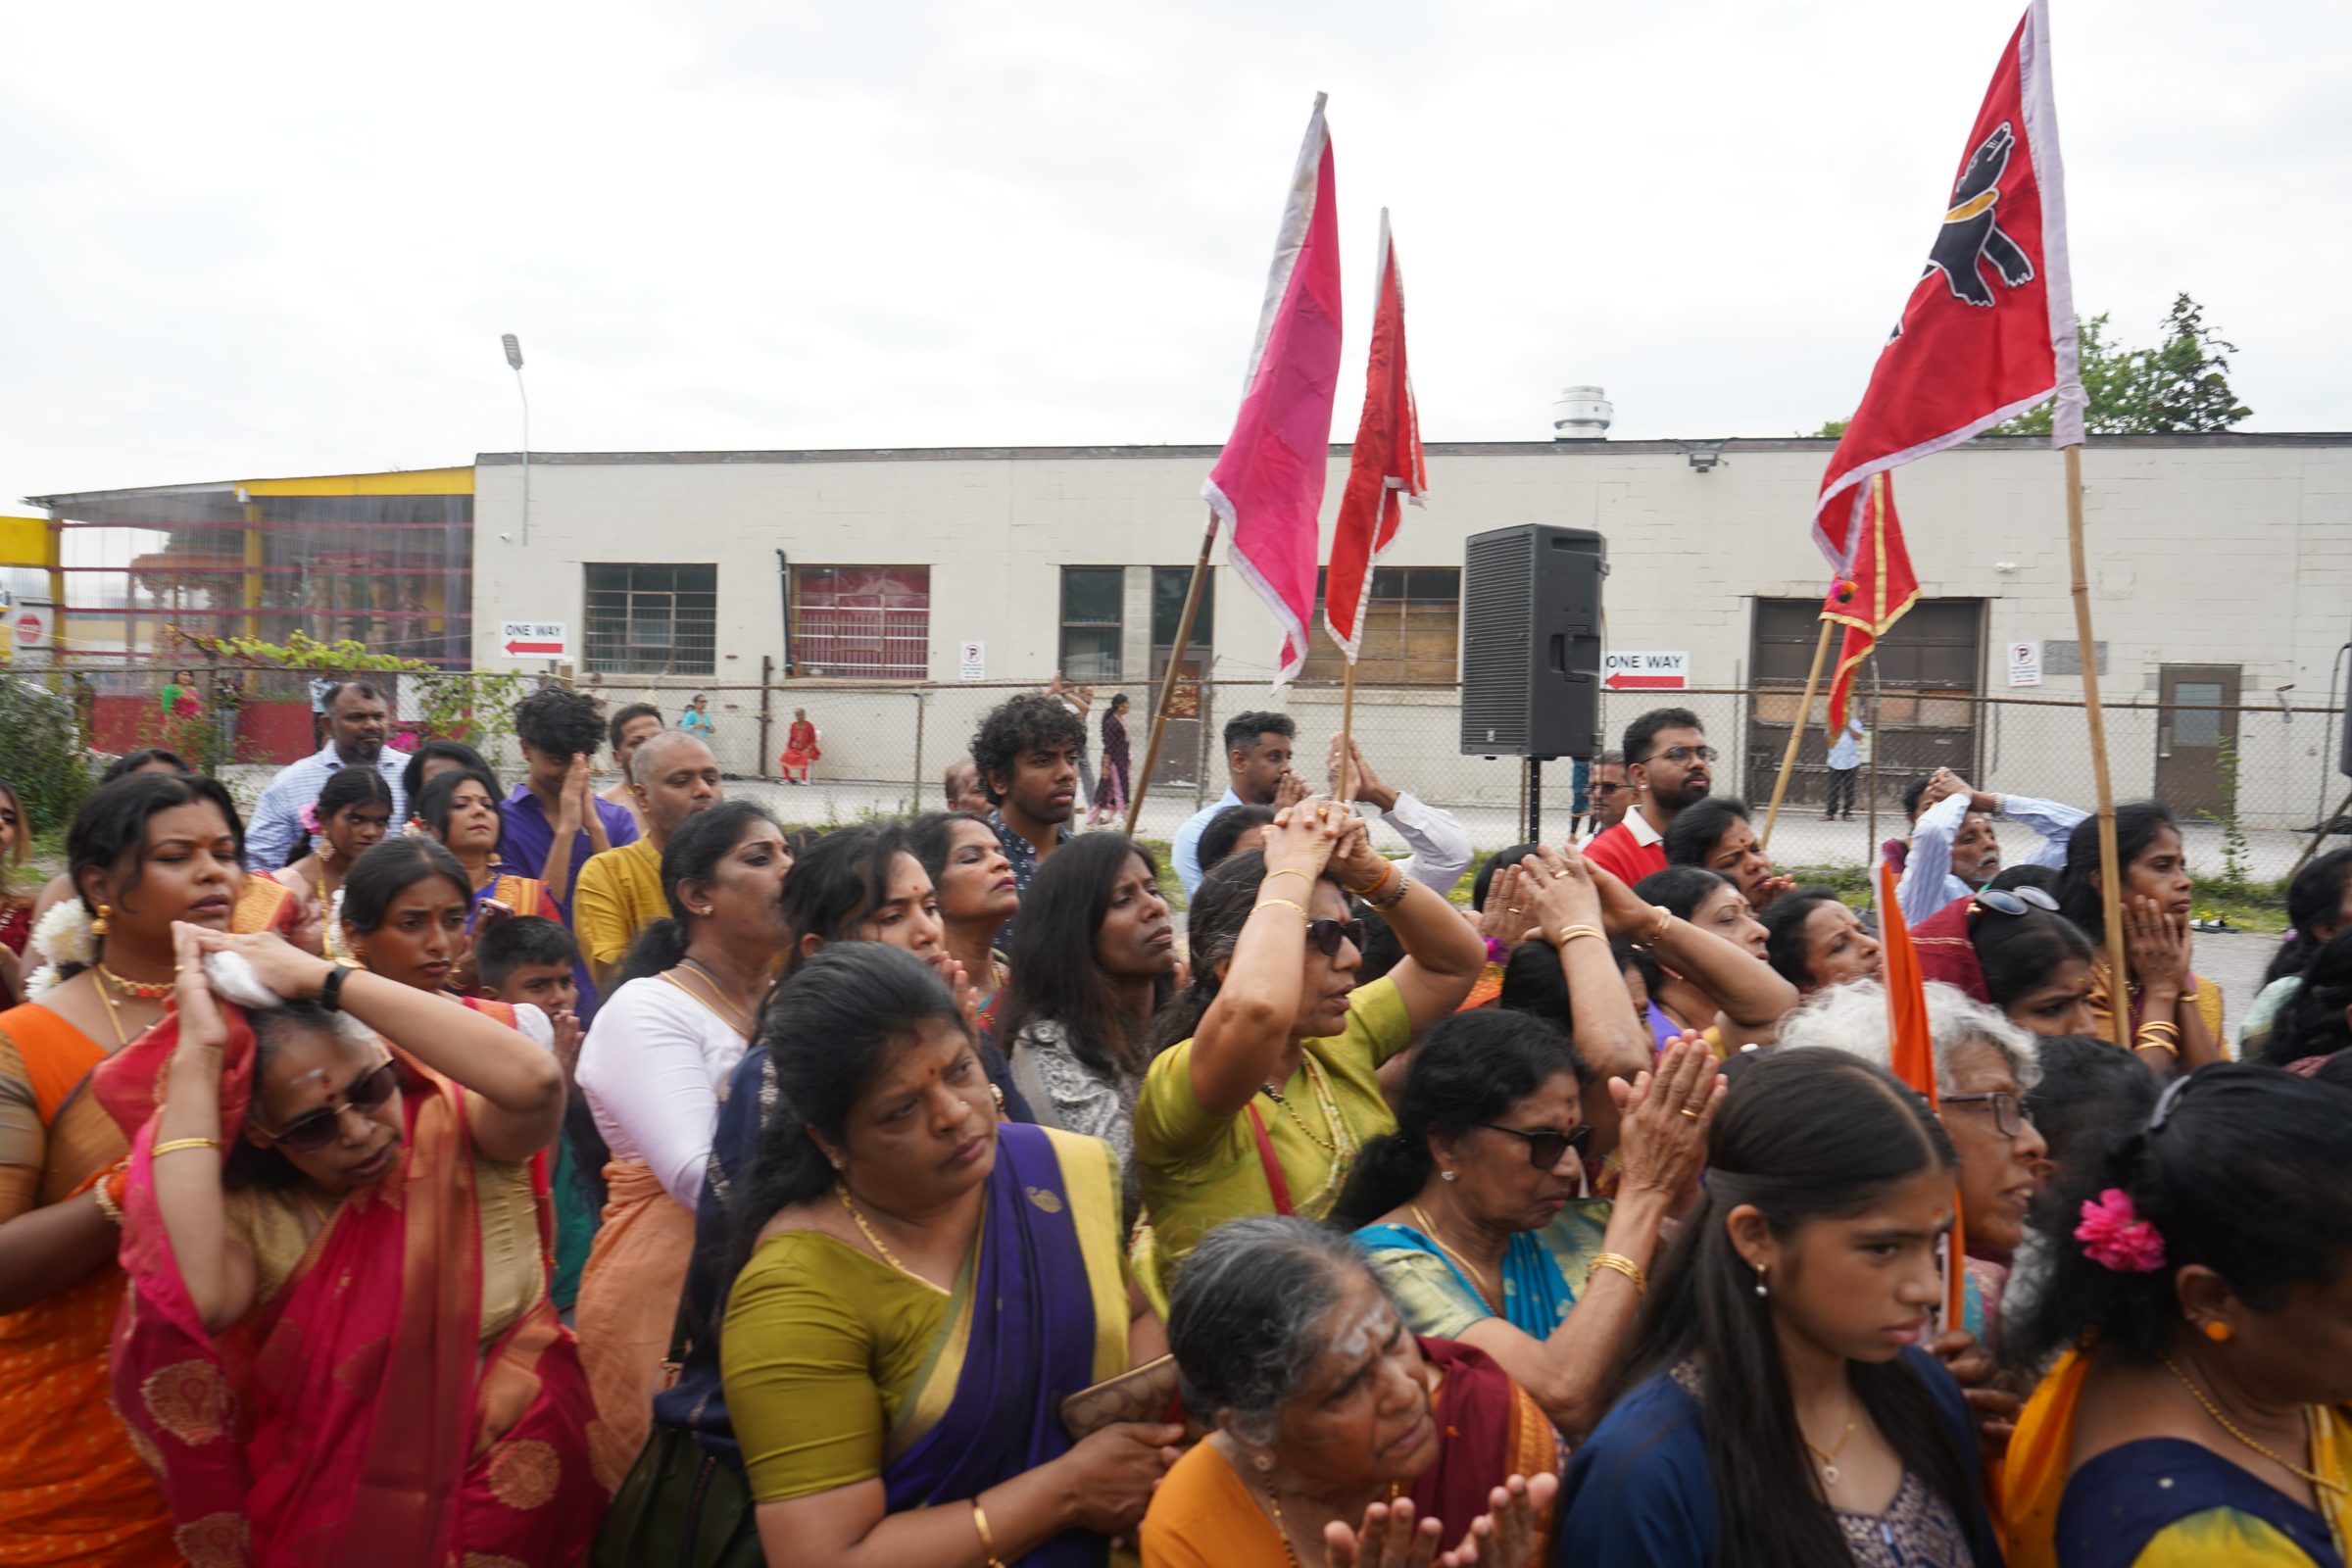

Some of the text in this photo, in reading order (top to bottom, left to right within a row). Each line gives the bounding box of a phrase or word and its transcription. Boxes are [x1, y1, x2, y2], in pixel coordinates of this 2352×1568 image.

[505, 624, 563, 637] ONE WAY
[1605, 656, 1683, 668] ONE WAY
